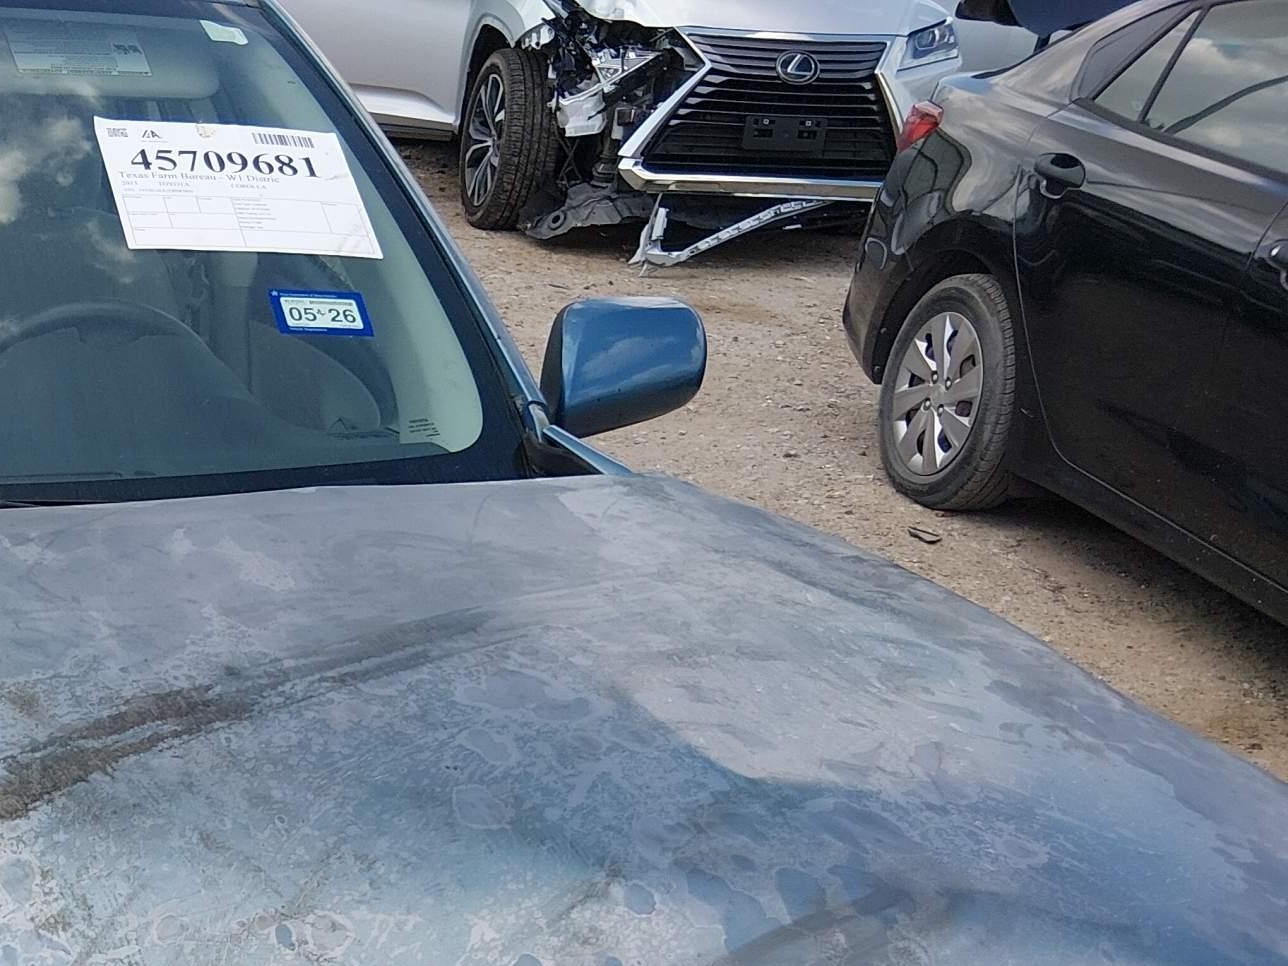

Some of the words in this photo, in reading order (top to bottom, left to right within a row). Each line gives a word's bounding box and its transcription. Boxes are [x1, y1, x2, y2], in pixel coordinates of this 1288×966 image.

[130, 148, 320, 178] 45709681
[119, 171, 149, 179] Texas
[152, 172, 177, 180] Farm
[289, 307, 317, 322] 05
[328, 308, 356, 323] 26
